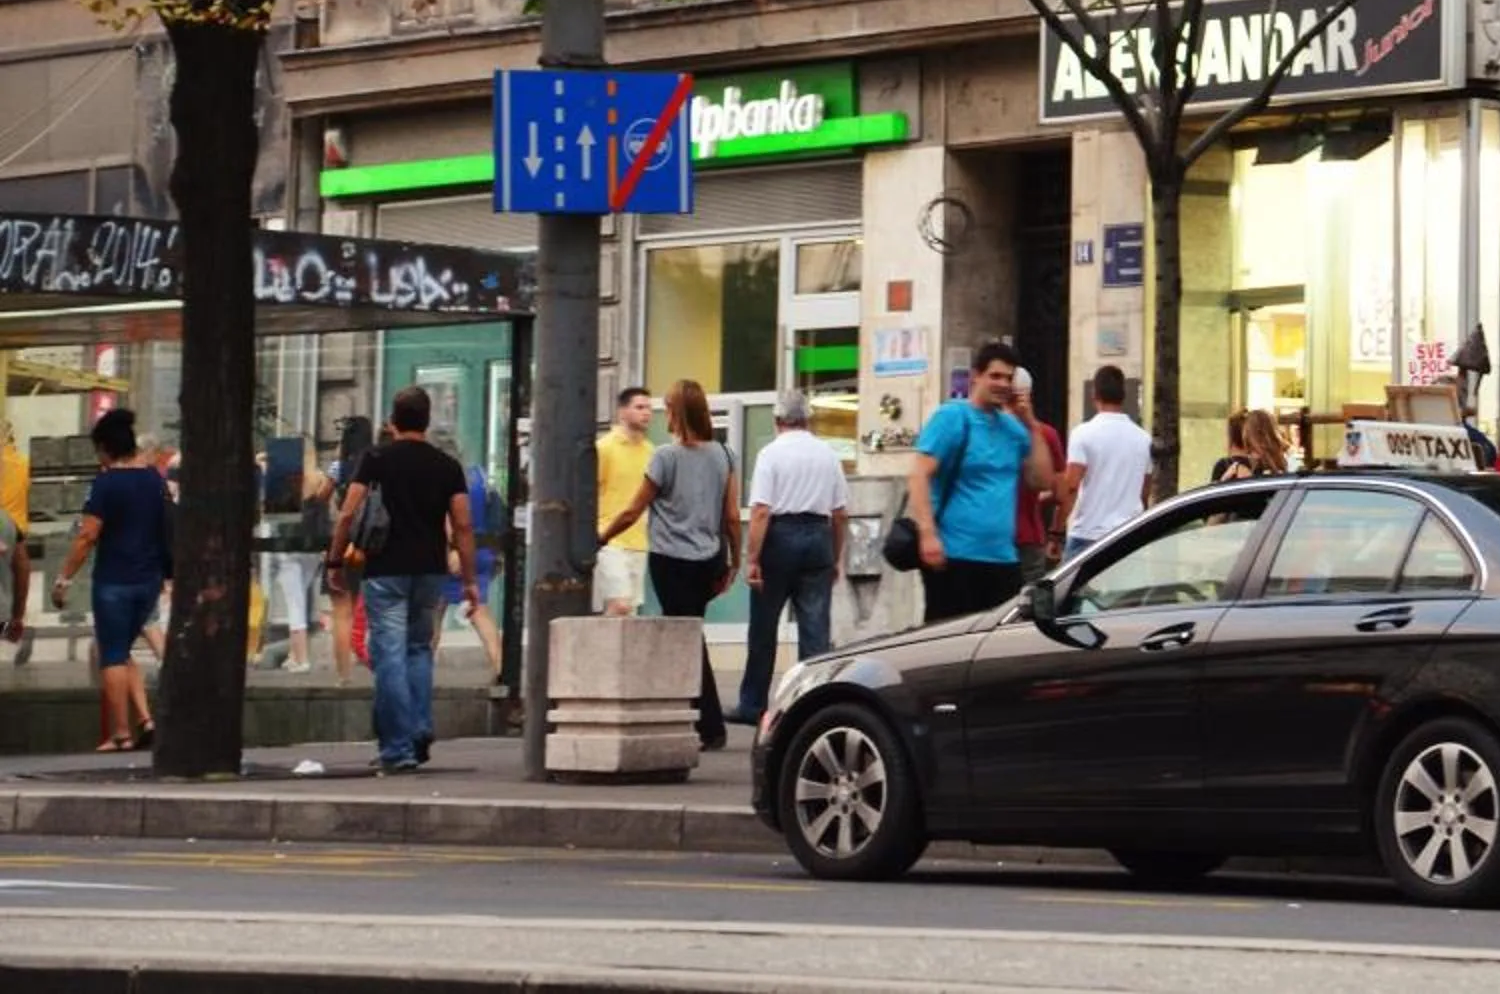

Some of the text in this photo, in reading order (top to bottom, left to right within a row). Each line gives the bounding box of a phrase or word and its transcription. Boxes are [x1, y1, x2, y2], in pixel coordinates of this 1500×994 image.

[690, 79, 824, 158] tpbanka
[1416, 342, 1446, 360] SVE
[1418, 434, 1472, 460] TAXI
